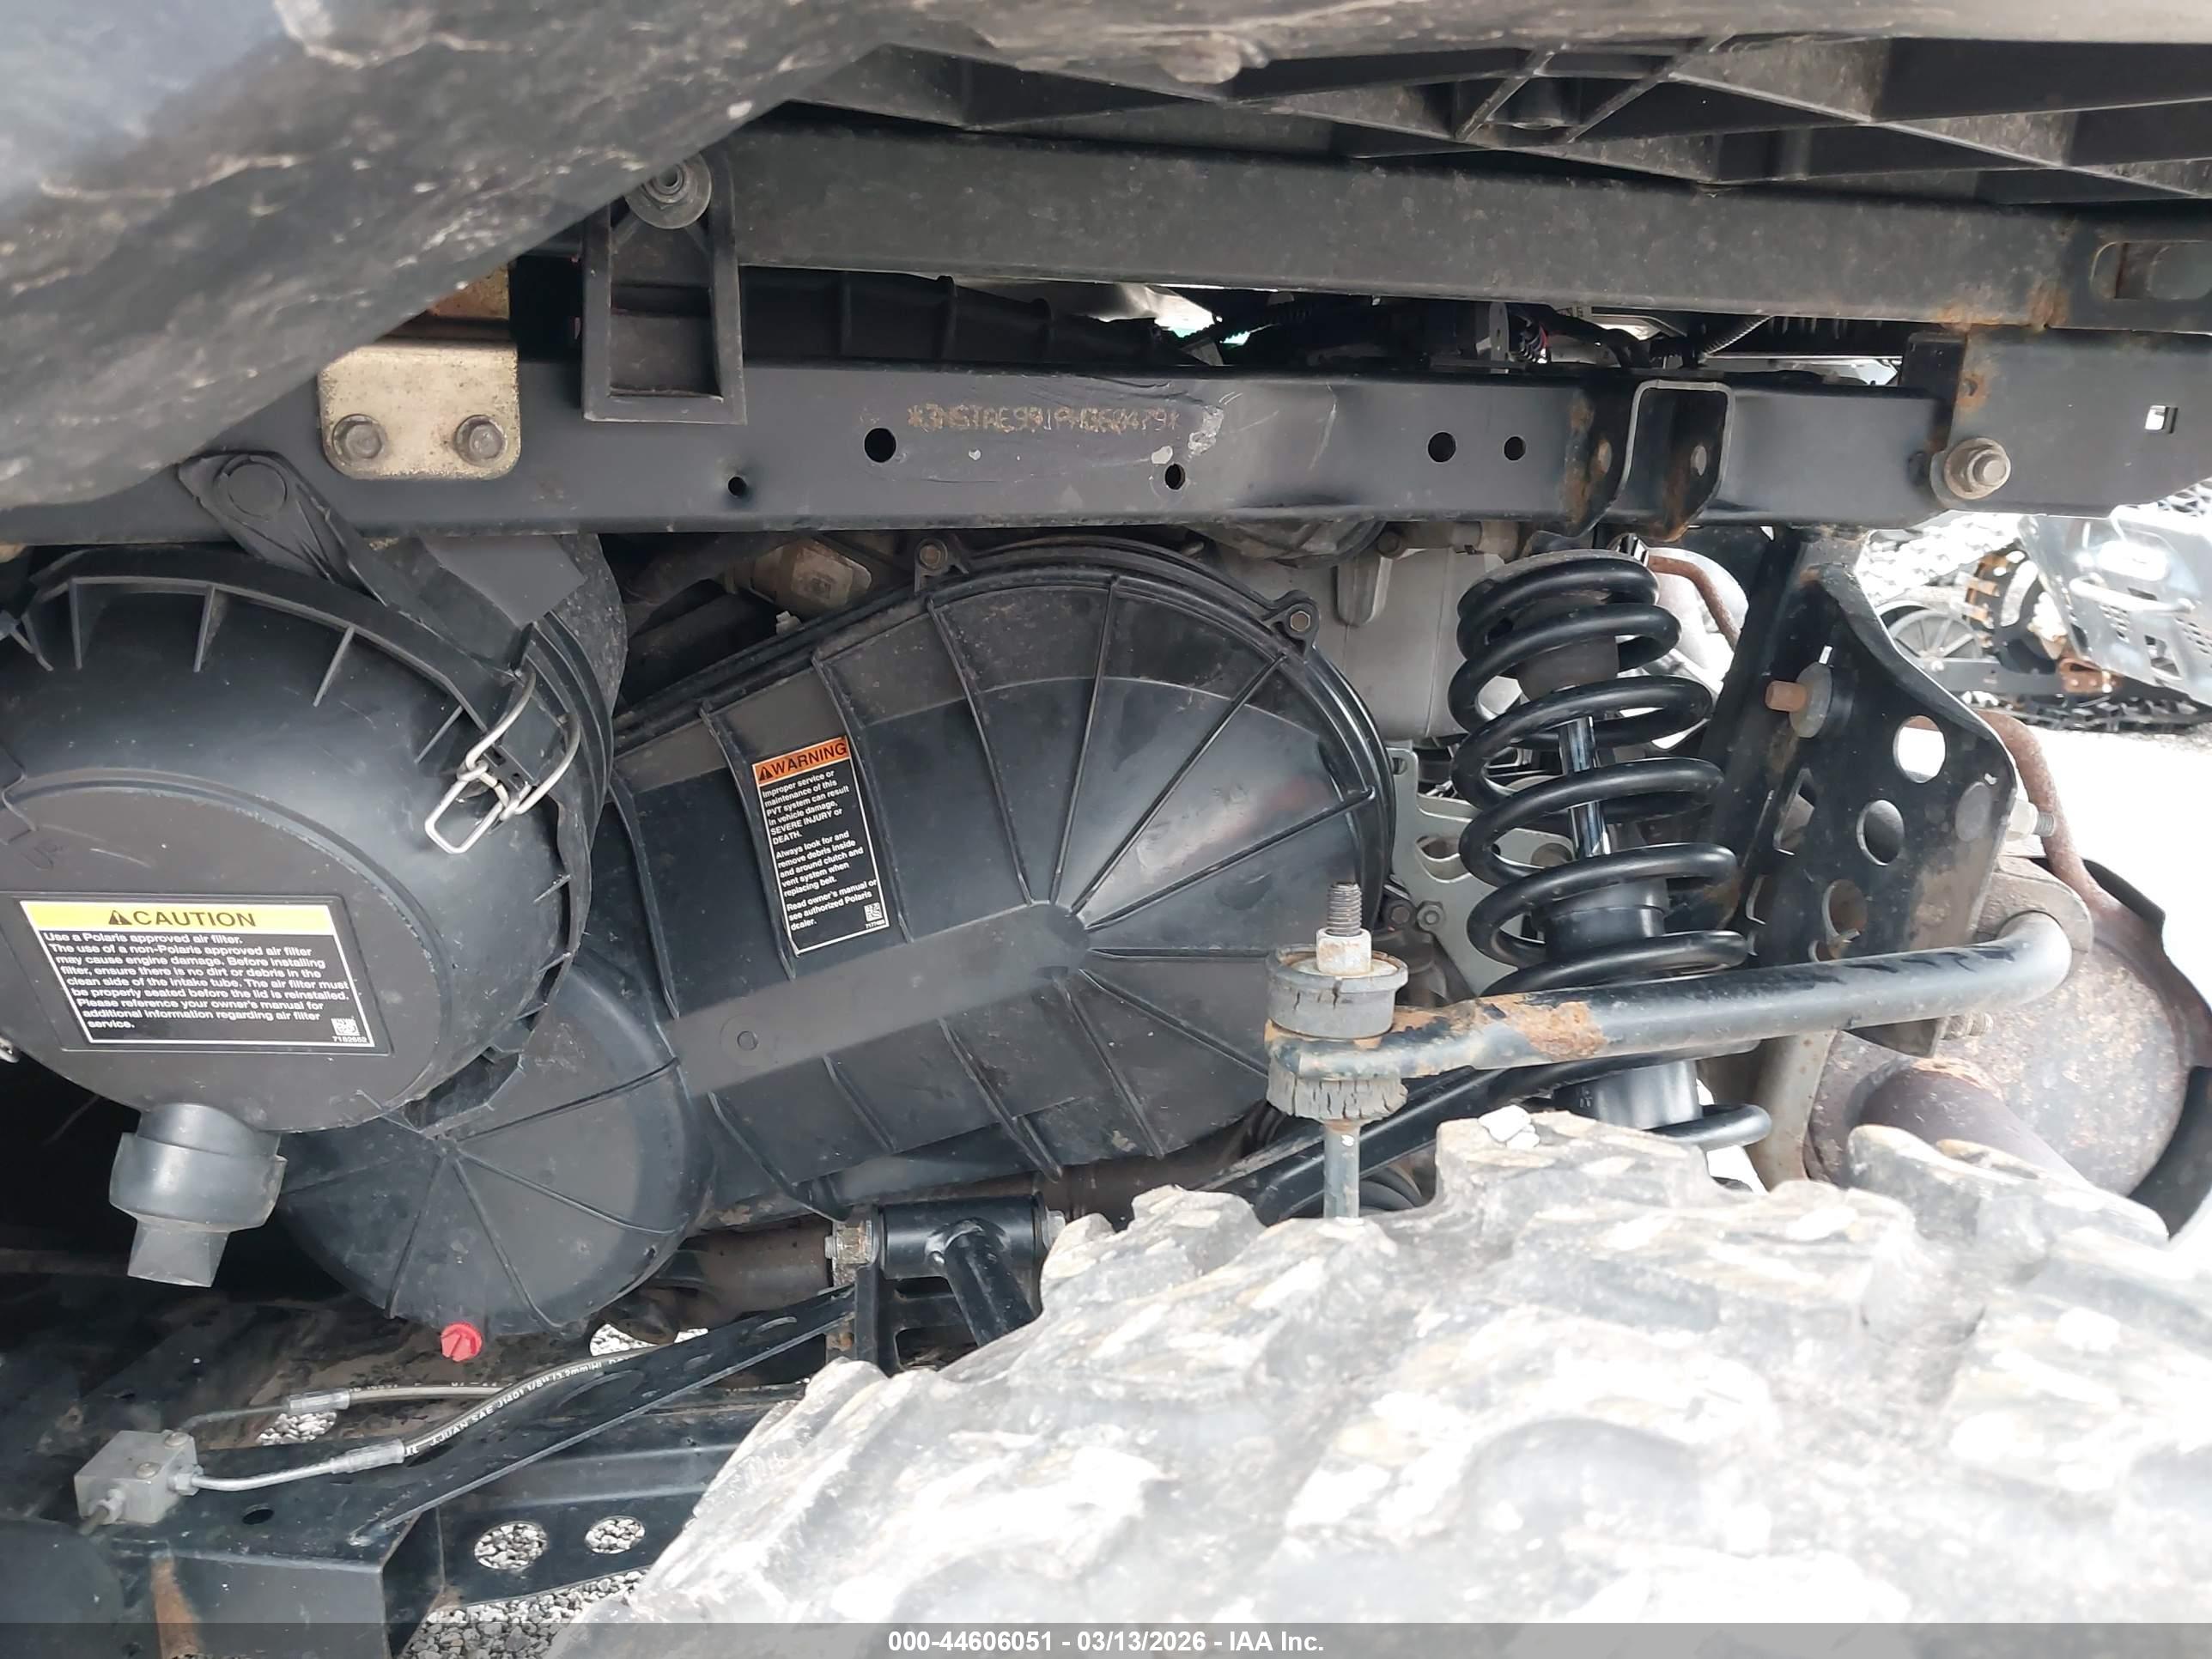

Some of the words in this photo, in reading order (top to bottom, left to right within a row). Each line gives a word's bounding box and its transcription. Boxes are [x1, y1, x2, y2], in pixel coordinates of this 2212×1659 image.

[771, 742, 848, 775] WARNING
[763, 783, 795, 798] Improper
[798, 774, 824, 787] service
[765, 788, 811, 807] maintenance
[813, 783, 821, 792] of
[822, 780, 837, 789] this
[767, 805, 781, 817] PVT
[783, 799, 811, 811] system
[811, 793, 826, 802] can
[827, 786, 849, 797] result
[778, 811, 804, 823] vehicle
[805, 801, 837, 814] damage,
[770, 820, 802, 836] SEVERE
[803, 811, 832, 825] INJURY
[773, 830, 802, 845] DEATH.
[776, 846, 803, 859] Always
[804, 840, 821, 850] look
[835, 830, 849, 841] and
[778, 855, 806, 868] remove
[807, 848, 831, 860] debris
[832, 840, 855, 851] inside
[780, 867, 794, 878] and
[796, 859, 823, 873] around
[823, 852, 848, 864] clutch
[848, 847, 864, 857] and
[781, 877, 799, 887] vent
[799, 869, 827, 882] system
[828, 862, 849, 872] when
[784, 882, 819, 896] replacing
[819, 876, 837, 886] belt.
[787, 899, 807, 911] Read
[807, 891, 838, 905] owner's
[839, 881, 867, 896] manual
[789, 912, 803, 921] see
[804, 898, 844, 916] authorized
[844, 891, 872, 904] Polaris
[134, 912, 255, 926] CAUTION
[44, 933, 70, 941] Use
[82, 933, 127, 942] Polaris
[130, 934, 190, 944] approved
[192, 934, 209, 943] air
[210, 934, 242, 944] filter.
[49, 944, 74, 952] The
[102, 945, 115, 953] of
[130, 945, 202, 954] non-Polaris
[204, 947, 263, 956] approved
[266, 947, 282, 956] air
[283, 947, 312, 956] filter
[56, 957, 82, 965] may
[125, 956, 167, 966] engine
[171, 957, 224, 967] damage.
[227, 957, 268, 966] Before
[270, 958, 325, 969] installing
[60, 966, 92, 975] filter,
[138, 967, 171, 975] there
[173, 967, 185, 975] is
[206, 968, 228, 976] dirt
[246, 969, 285, 977] debris
[287, 969, 299, 977] in
[301, 969, 321, 978] the
[91, 988, 141, 998] properly
[188, 988, 228, 997] before
[230, 989, 251, 998] the
[252, 990, 269, 999] lid
[270, 990, 283, 999] is
[284, 991, 349, 1000] reinstalled.
[103, 977, 129, 986] side
[131, 977, 144, 986] of
[169, 978, 208, 987] intake
[210, 978, 242, 988] tube.
[244, 979, 268, 988] The
[270, 980, 286, 988] air
[289, 980, 316, 988] filter
[121, 999, 179, 1007] reference
[180, 1000, 208, 1009] your
[211, 1000, 258, 1009] owner's
[307, 1001, 324, 1010] for
[144, 1010, 213, 1018] information
[216, 1011, 273, 1021] regarding
[293, 1012, 320, 1020] filter
[471, 1407, 494, 1423] SAE
[497, 1389, 525, 1409] J1401
